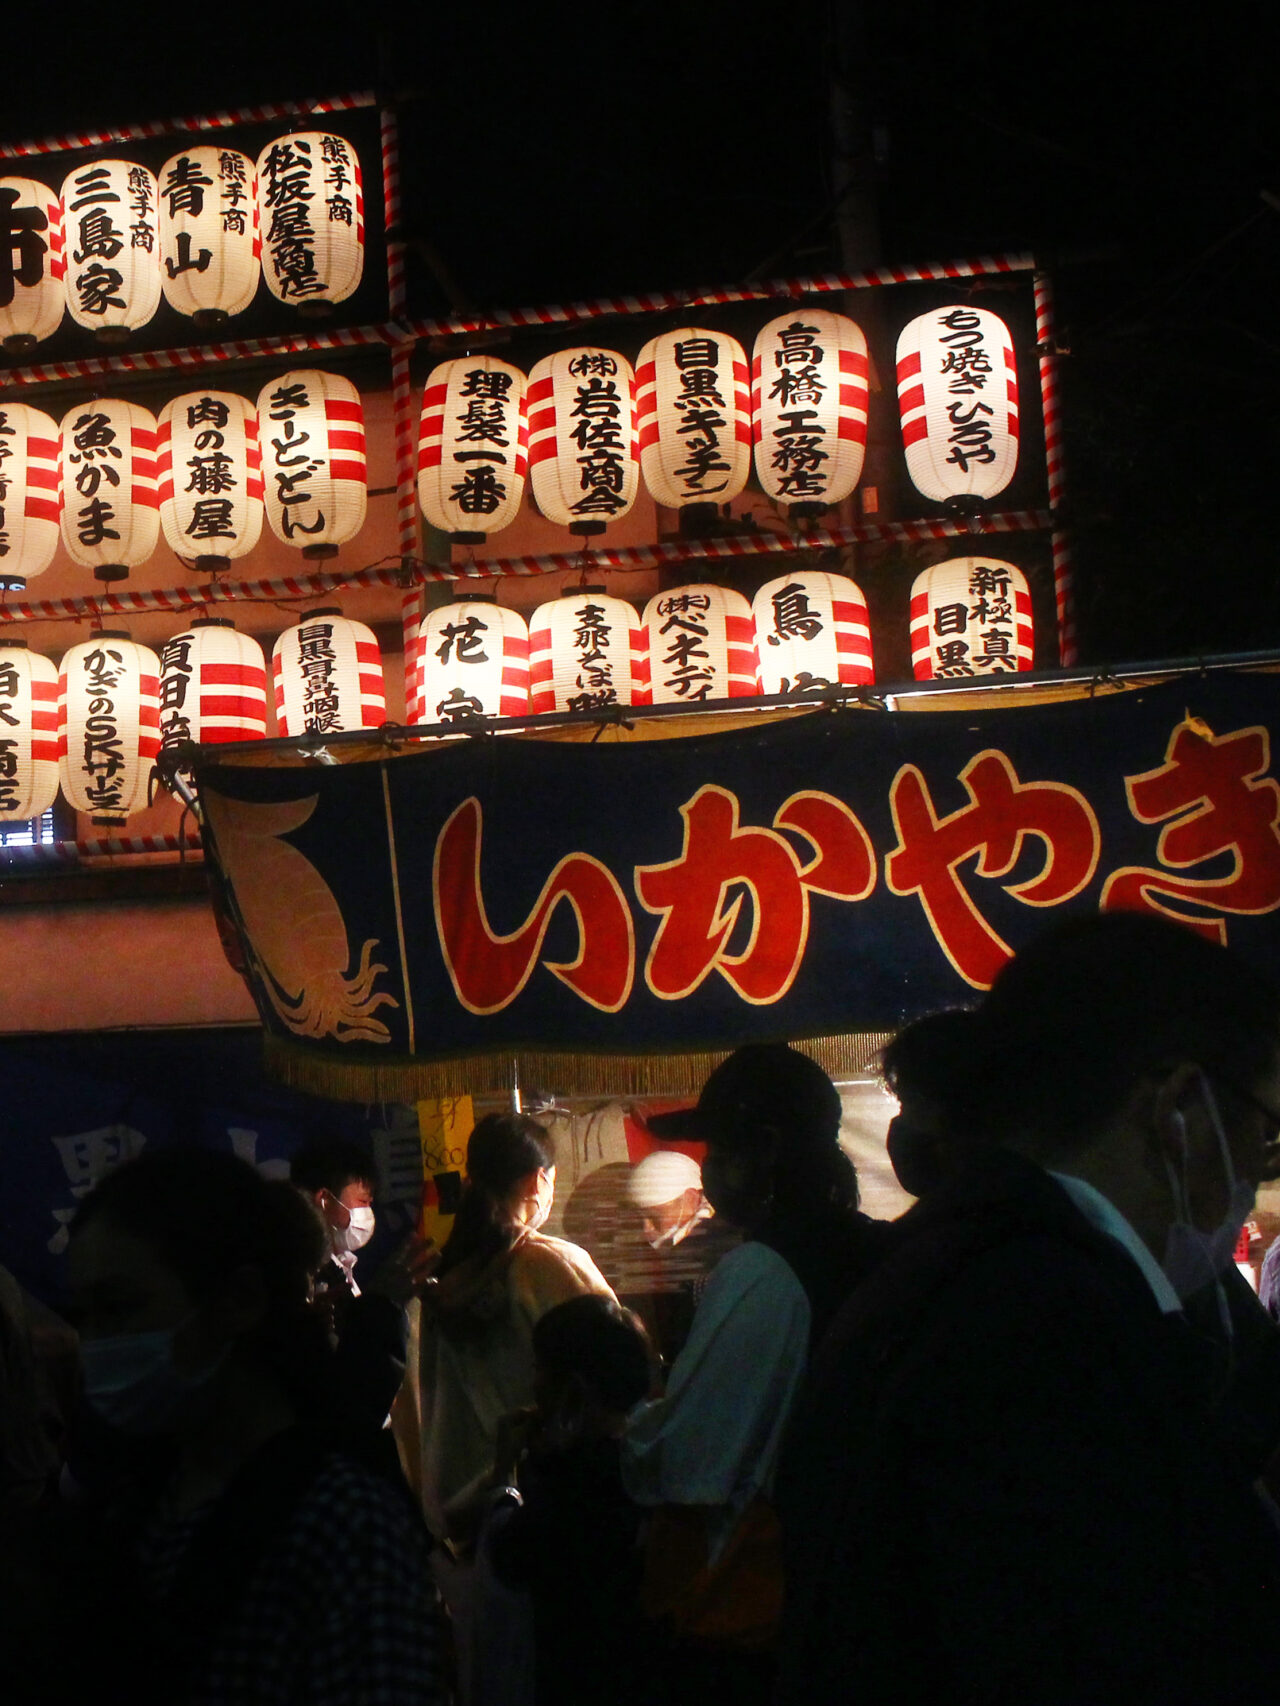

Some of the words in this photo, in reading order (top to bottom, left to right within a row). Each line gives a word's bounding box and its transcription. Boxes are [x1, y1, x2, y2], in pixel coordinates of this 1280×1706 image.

[69, 168, 128, 315] 三島家
[126, 166, 155, 253] 熊手商
[161, 157, 214, 280] 青山
[218, 151, 248, 236] 熊手商
[261, 140, 330, 299] 松坂屋商店
[319, 135, 354, 227] 熊手商
[184, 397, 238, 540] 肉の藤屋
[448, 369, 514, 515] 理髪一番
[673, 337, 731, 498] 目黒キッチン
[767, 321, 829, 497] 高橋工務店
[69, 413, 123, 546] 魚かま
[297, 623, 344, 734] 目黒耳鼻咽喉
[968, 566, 1016, 673] 新極真
[432, 725, 1280, 1015] いかやき
